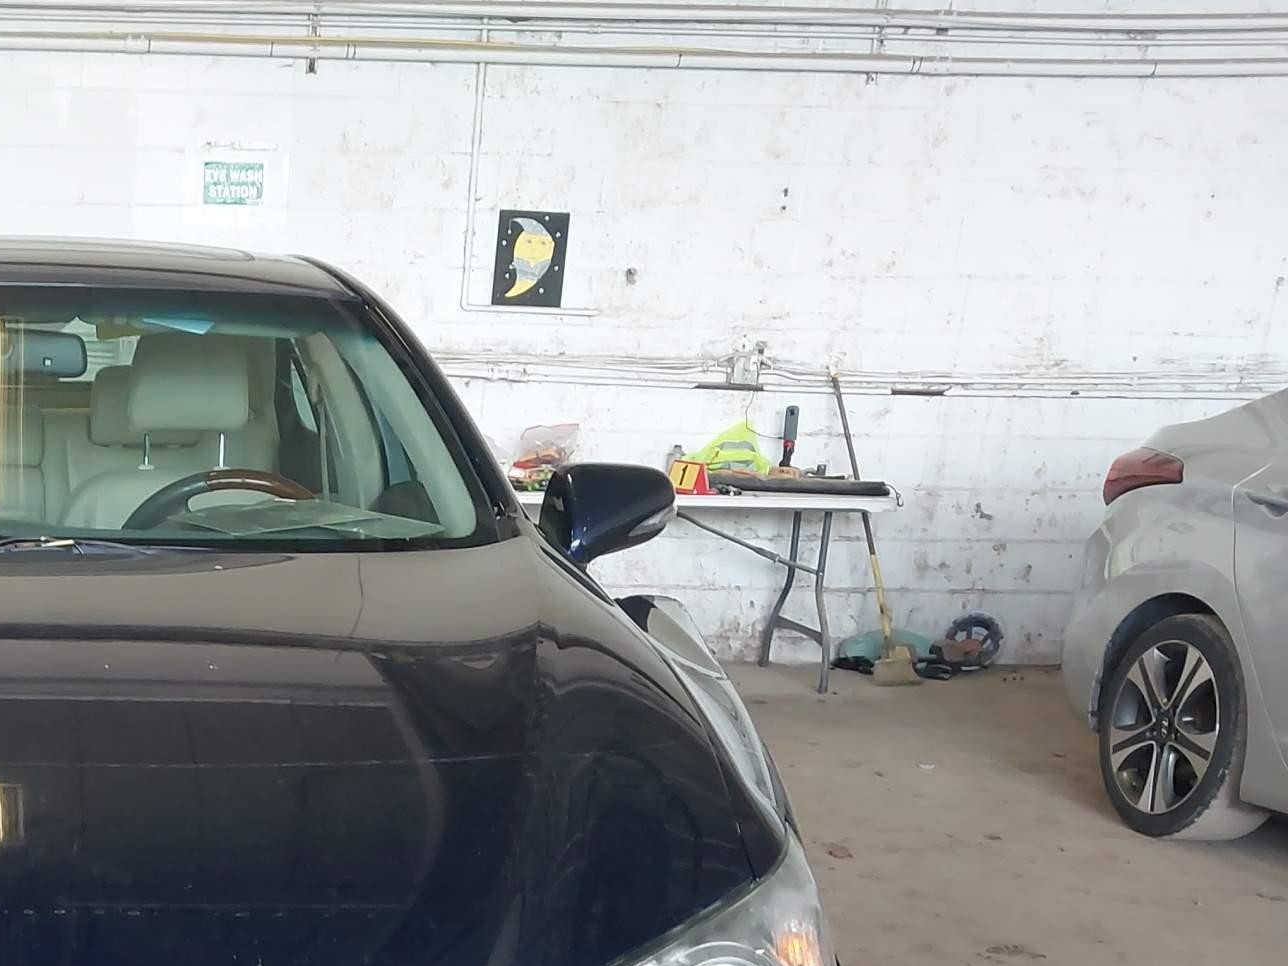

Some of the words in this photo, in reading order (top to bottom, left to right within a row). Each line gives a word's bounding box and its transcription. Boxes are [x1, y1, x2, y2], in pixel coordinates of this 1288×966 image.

[204, 168, 228, 183] EYE
[230, 168, 263, 182] WASH
[208, 184, 258, 199] STATION
[679, 464, 689, 486] 1
